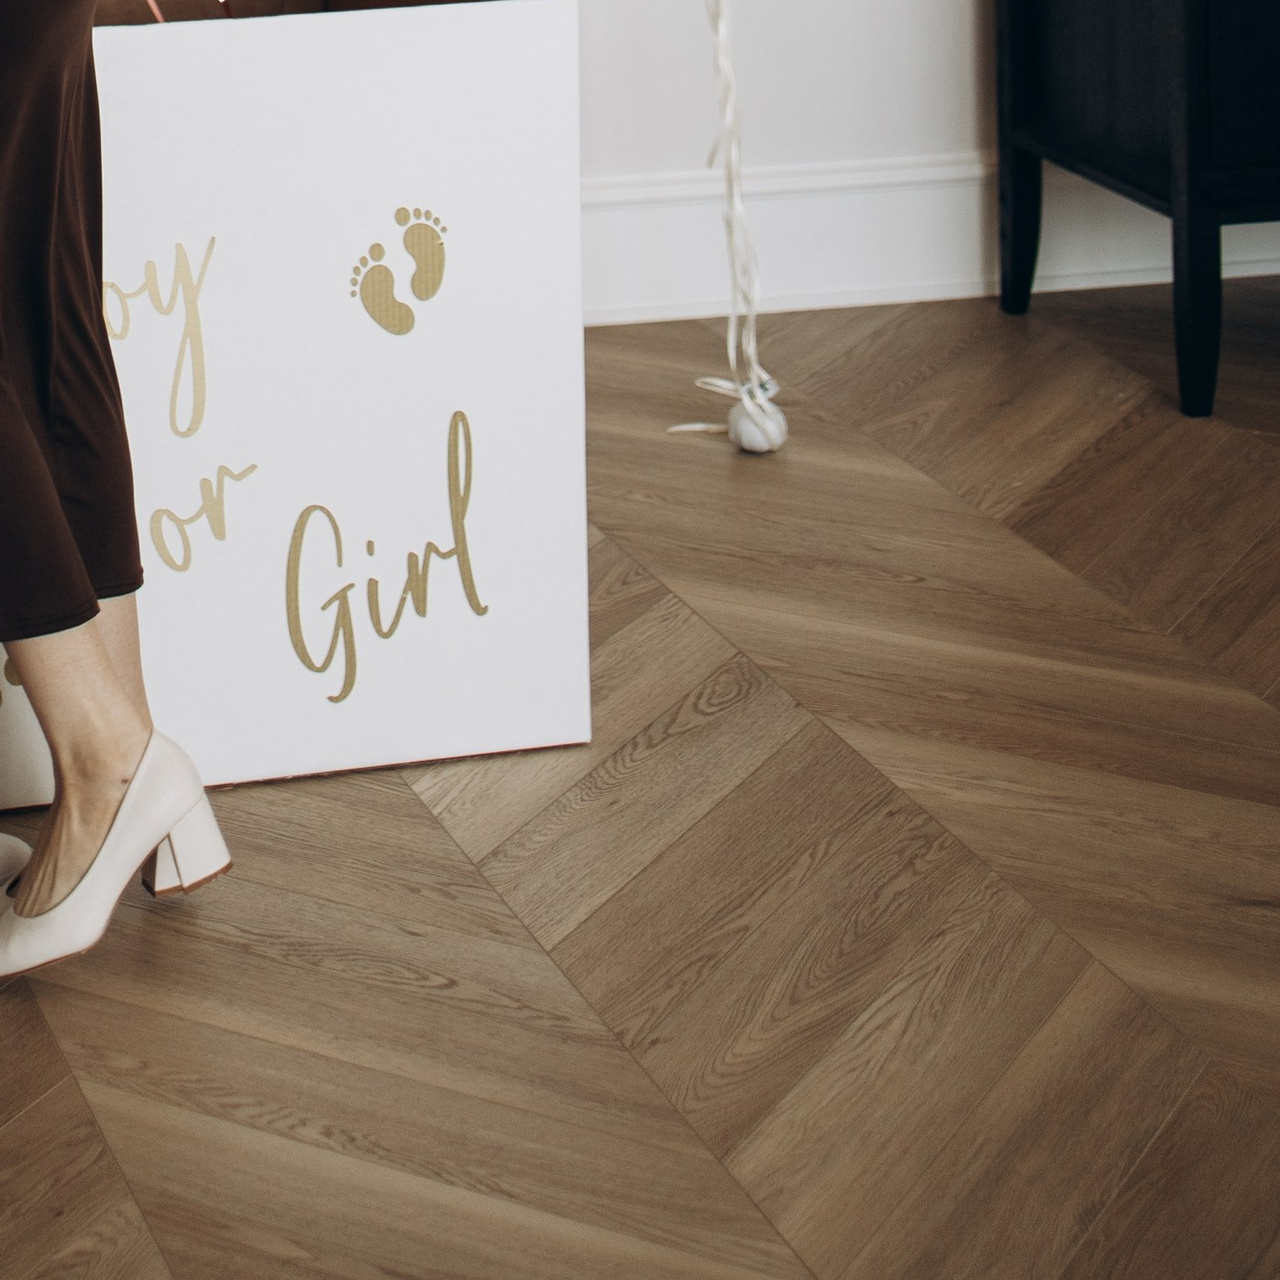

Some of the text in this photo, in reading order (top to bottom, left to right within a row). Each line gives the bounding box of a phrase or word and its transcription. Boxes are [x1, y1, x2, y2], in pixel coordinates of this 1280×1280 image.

[102, 235, 216, 439] oy
[149, 464, 258, 573] or
[285, 410, 489, 704] Girl
